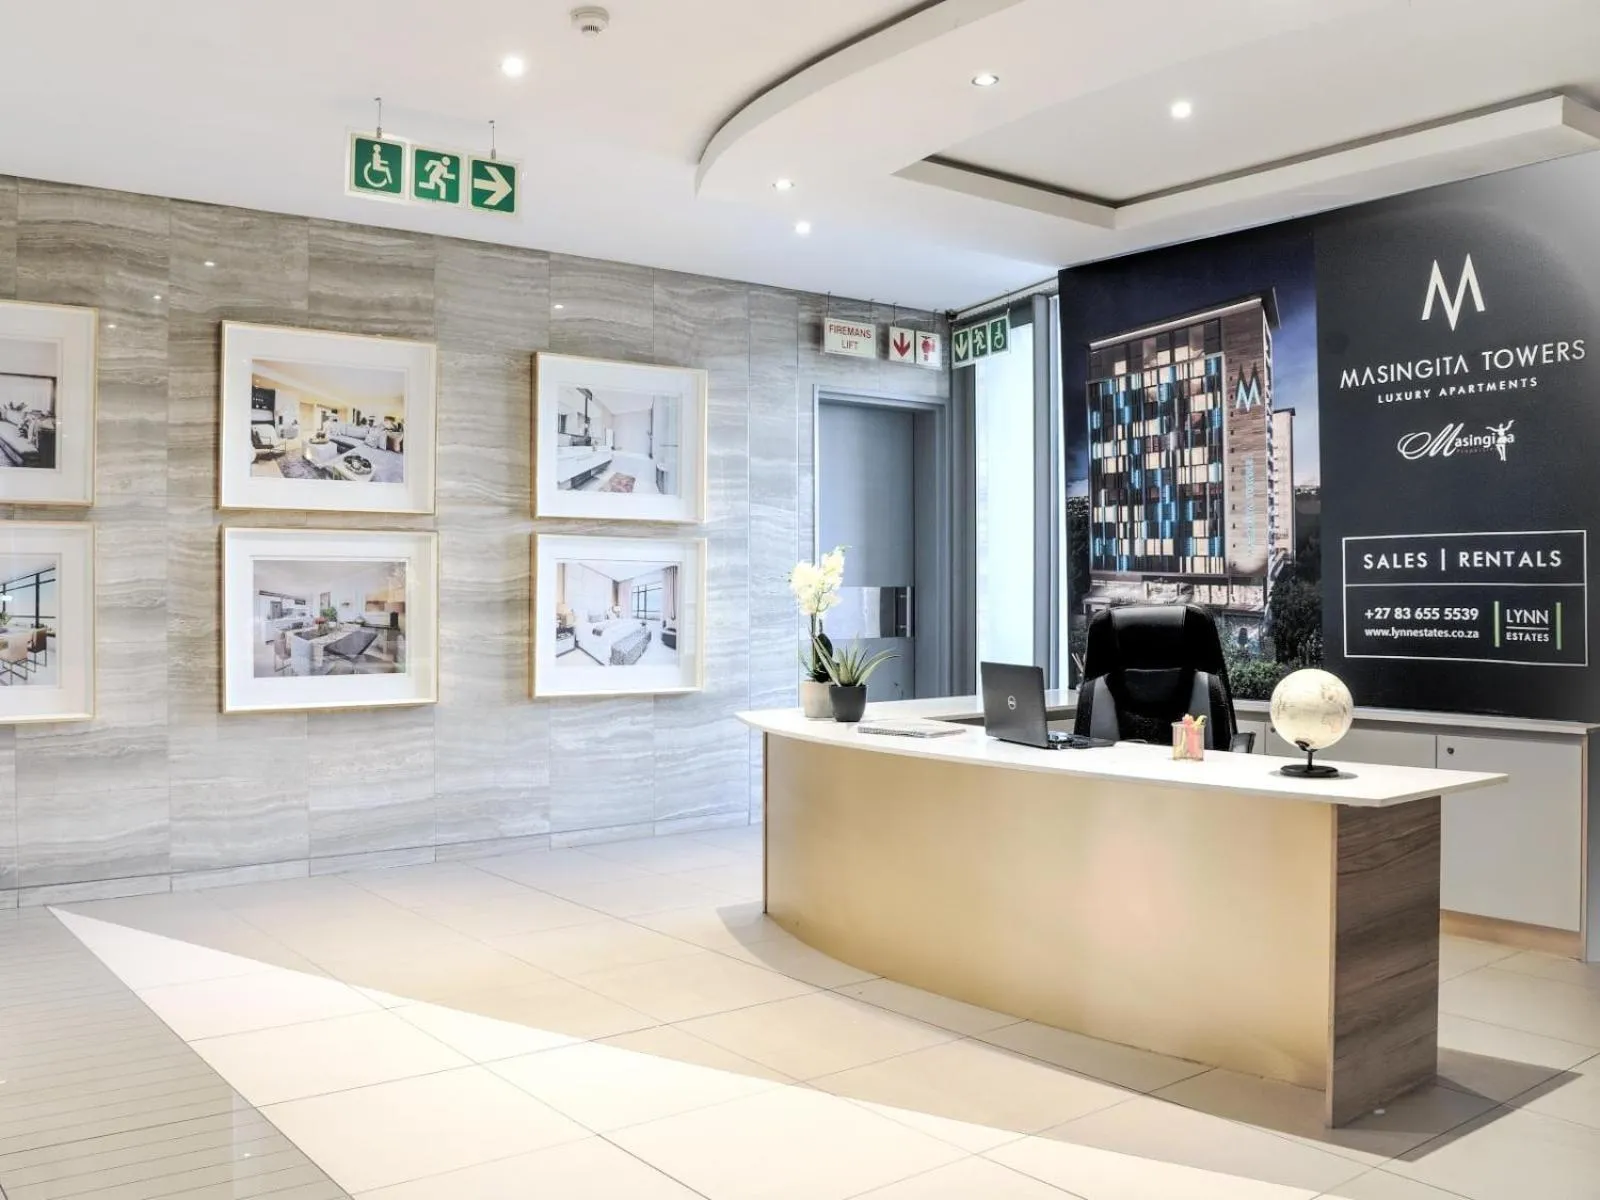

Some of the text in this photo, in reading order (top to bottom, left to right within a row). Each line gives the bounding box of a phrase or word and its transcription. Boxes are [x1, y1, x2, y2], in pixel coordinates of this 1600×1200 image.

[829, 324, 872, 339] FIREMANS
[841, 339, 858, 350] LIFT
[1340, 339, 1586, 389] MASINGITA TOWERS
[1377, 376, 1538, 404] LUXURY APARTMENTS
[1363, 550, 1562, 570] SALES RENTALS
[1364, 608, 1479, 621] +27 83 655 5539
[1506, 608, 1549, 625] LYNN
[1364, 627, 1480, 639] www.lynnestates.co.za
[1506, 632, 1549, 642] ESTATES
